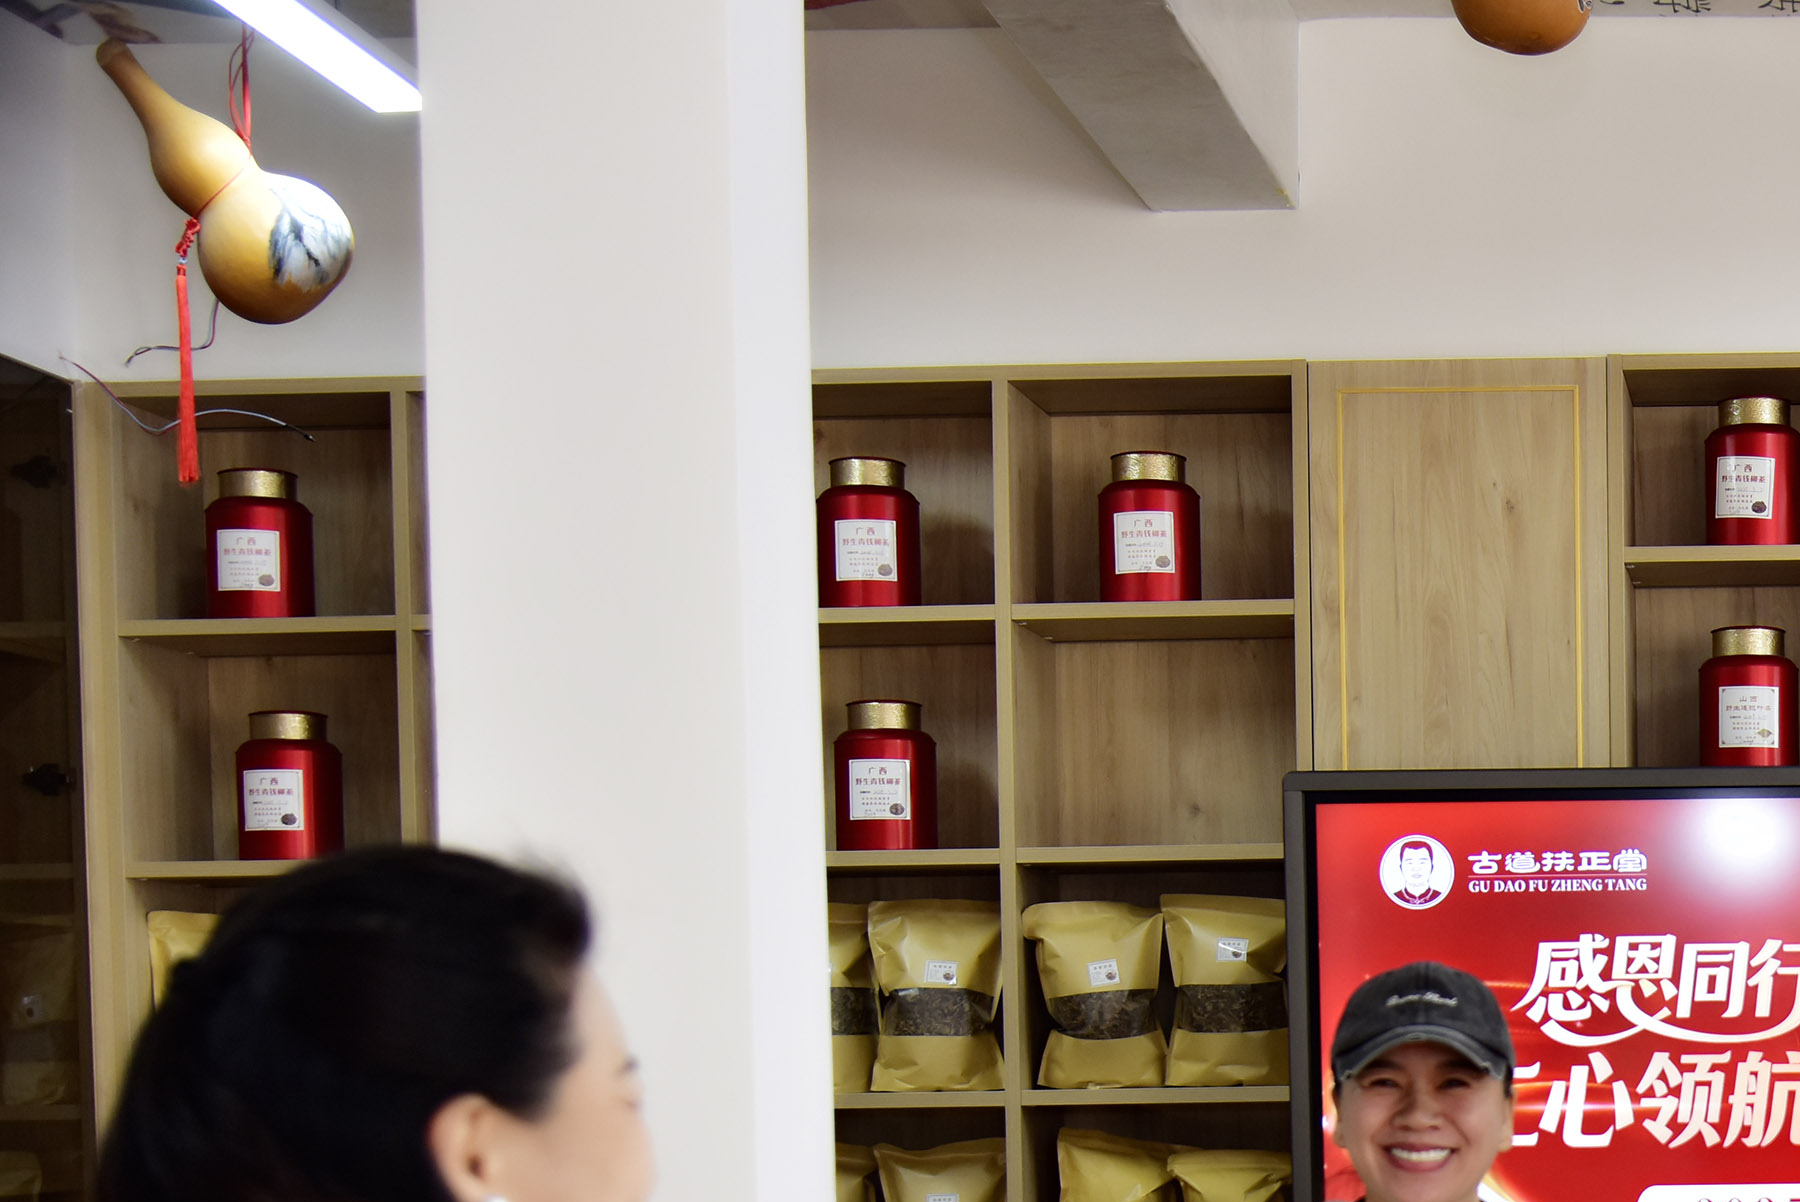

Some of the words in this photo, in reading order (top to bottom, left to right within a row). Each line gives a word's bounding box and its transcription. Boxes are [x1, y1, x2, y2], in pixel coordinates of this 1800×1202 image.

[1734, 464, 1752, 472] 广西
[1134, 519, 1153, 527] 广西
[856, 527, 875, 535] 广西
[236, 537, 256, 545] 广西
[260, 777, 279, 785] 广西
[1467, 848, 1647, 874] 古道扶正堂
[1468, 880, 1490, 893] GU
[1494, 879, 1526, 892] DAO
[1529, 879, 1548, 892] FU
[1551, 878, 1603, 891] ZHENG
[1605, 877, 1647, 891] TANG
